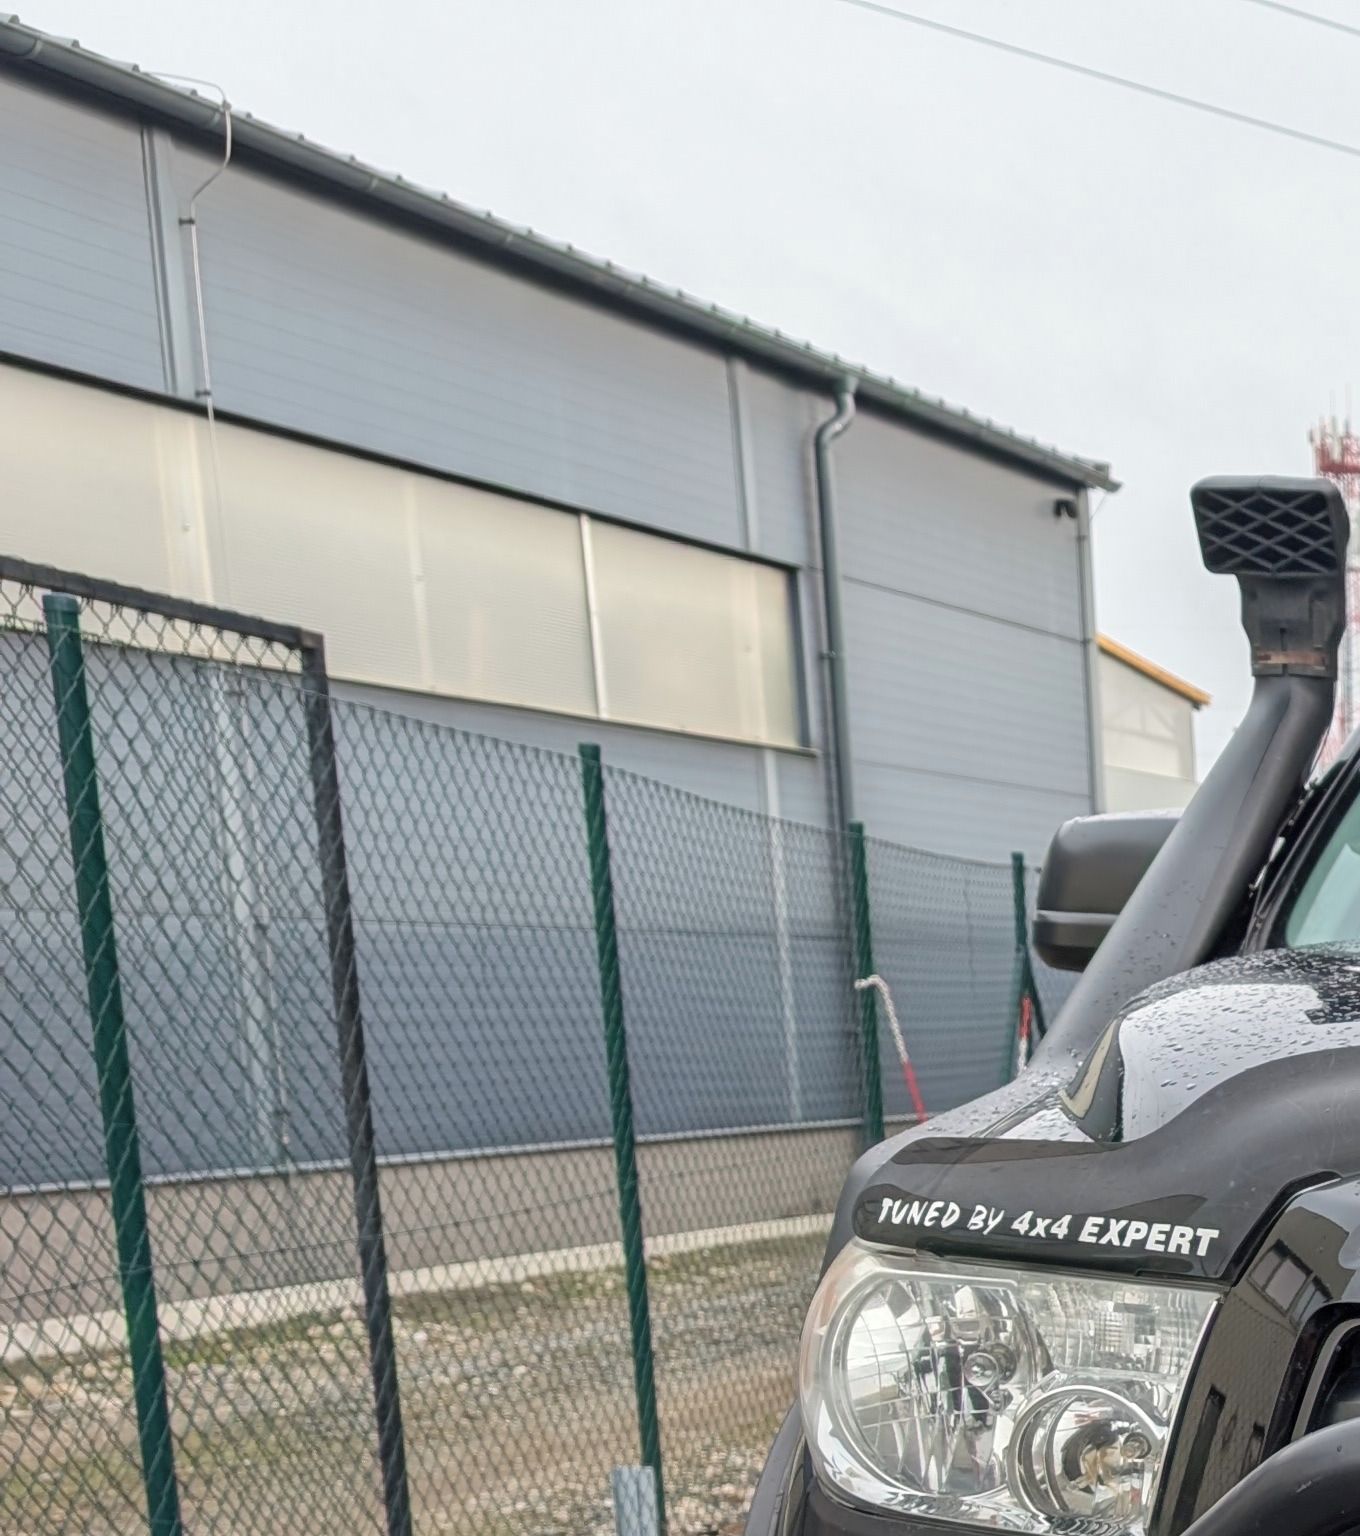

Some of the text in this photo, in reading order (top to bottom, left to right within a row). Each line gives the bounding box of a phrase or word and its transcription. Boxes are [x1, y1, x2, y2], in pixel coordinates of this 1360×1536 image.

[878, 1197, 1220, 1257] TUNED BY 4x4 EXPERT
